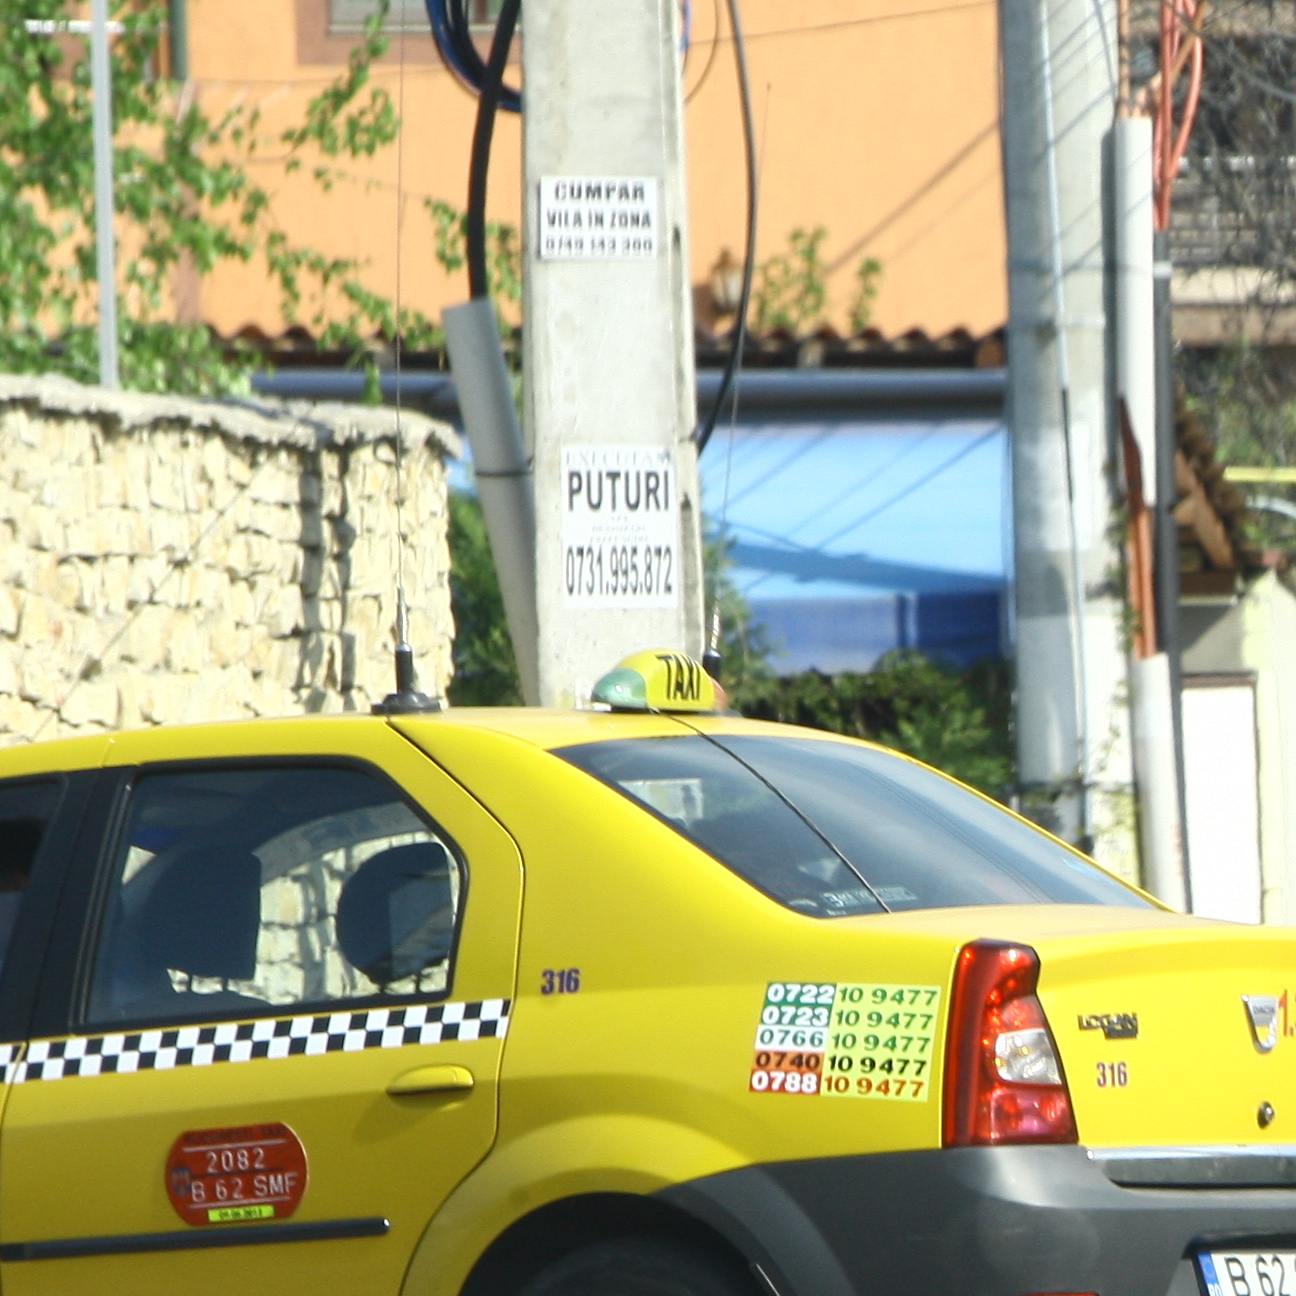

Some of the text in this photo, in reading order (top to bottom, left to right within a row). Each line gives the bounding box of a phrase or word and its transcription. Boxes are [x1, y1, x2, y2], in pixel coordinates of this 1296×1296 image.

[555, 181, 645, 201] CUMPAR
[547, 208, 651, 228] VILA IN ZONA
[567, 470, 671, 512] PUTURI
[566, 545, 673, 595] 0731.995.872
[655, 653, 700, 700] TAXI
[541, 969, 580, 995] 316
[767, 984, 938, 1006] 0722 10 9477
[761, 1006, 933, 1031] 0723 10 9477
[759, 1029, 931, 1054] 0766 10 9477
[755, 1052, 927, 1076] 0740 10 9477
[1096, 1062, 1128, 1087] 316
[751, 1071, 924, 1098] 0788 10 9477
[206, 1147, 266, 1174] 2082
[192, 1172, 298, 1202] B 62 SMF
